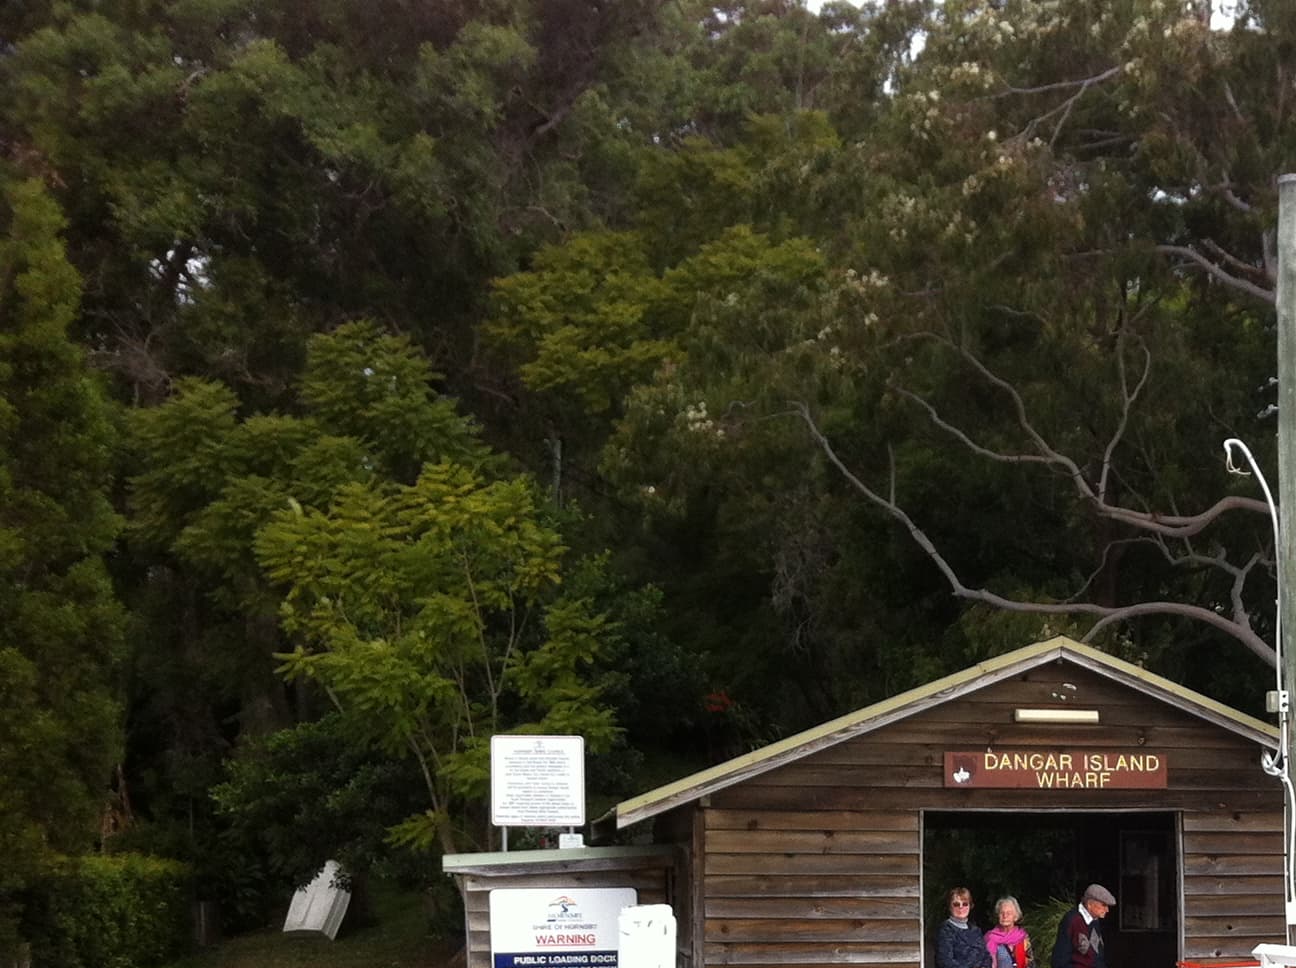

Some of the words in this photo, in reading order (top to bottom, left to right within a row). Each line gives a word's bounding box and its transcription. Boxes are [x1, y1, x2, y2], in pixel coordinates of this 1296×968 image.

[984, 753, 1073, 771] DANGAR
[1083, 754, 1160, 772] ISLAND
[1036, 772, 1111, 788] WHARF
[535, 933, 596, 944] WARNING
[513, 956, 547, 965] PUBLIC
[548, 955, 588, 964] LOADING
[590, 954, 617, 963] DOCK
